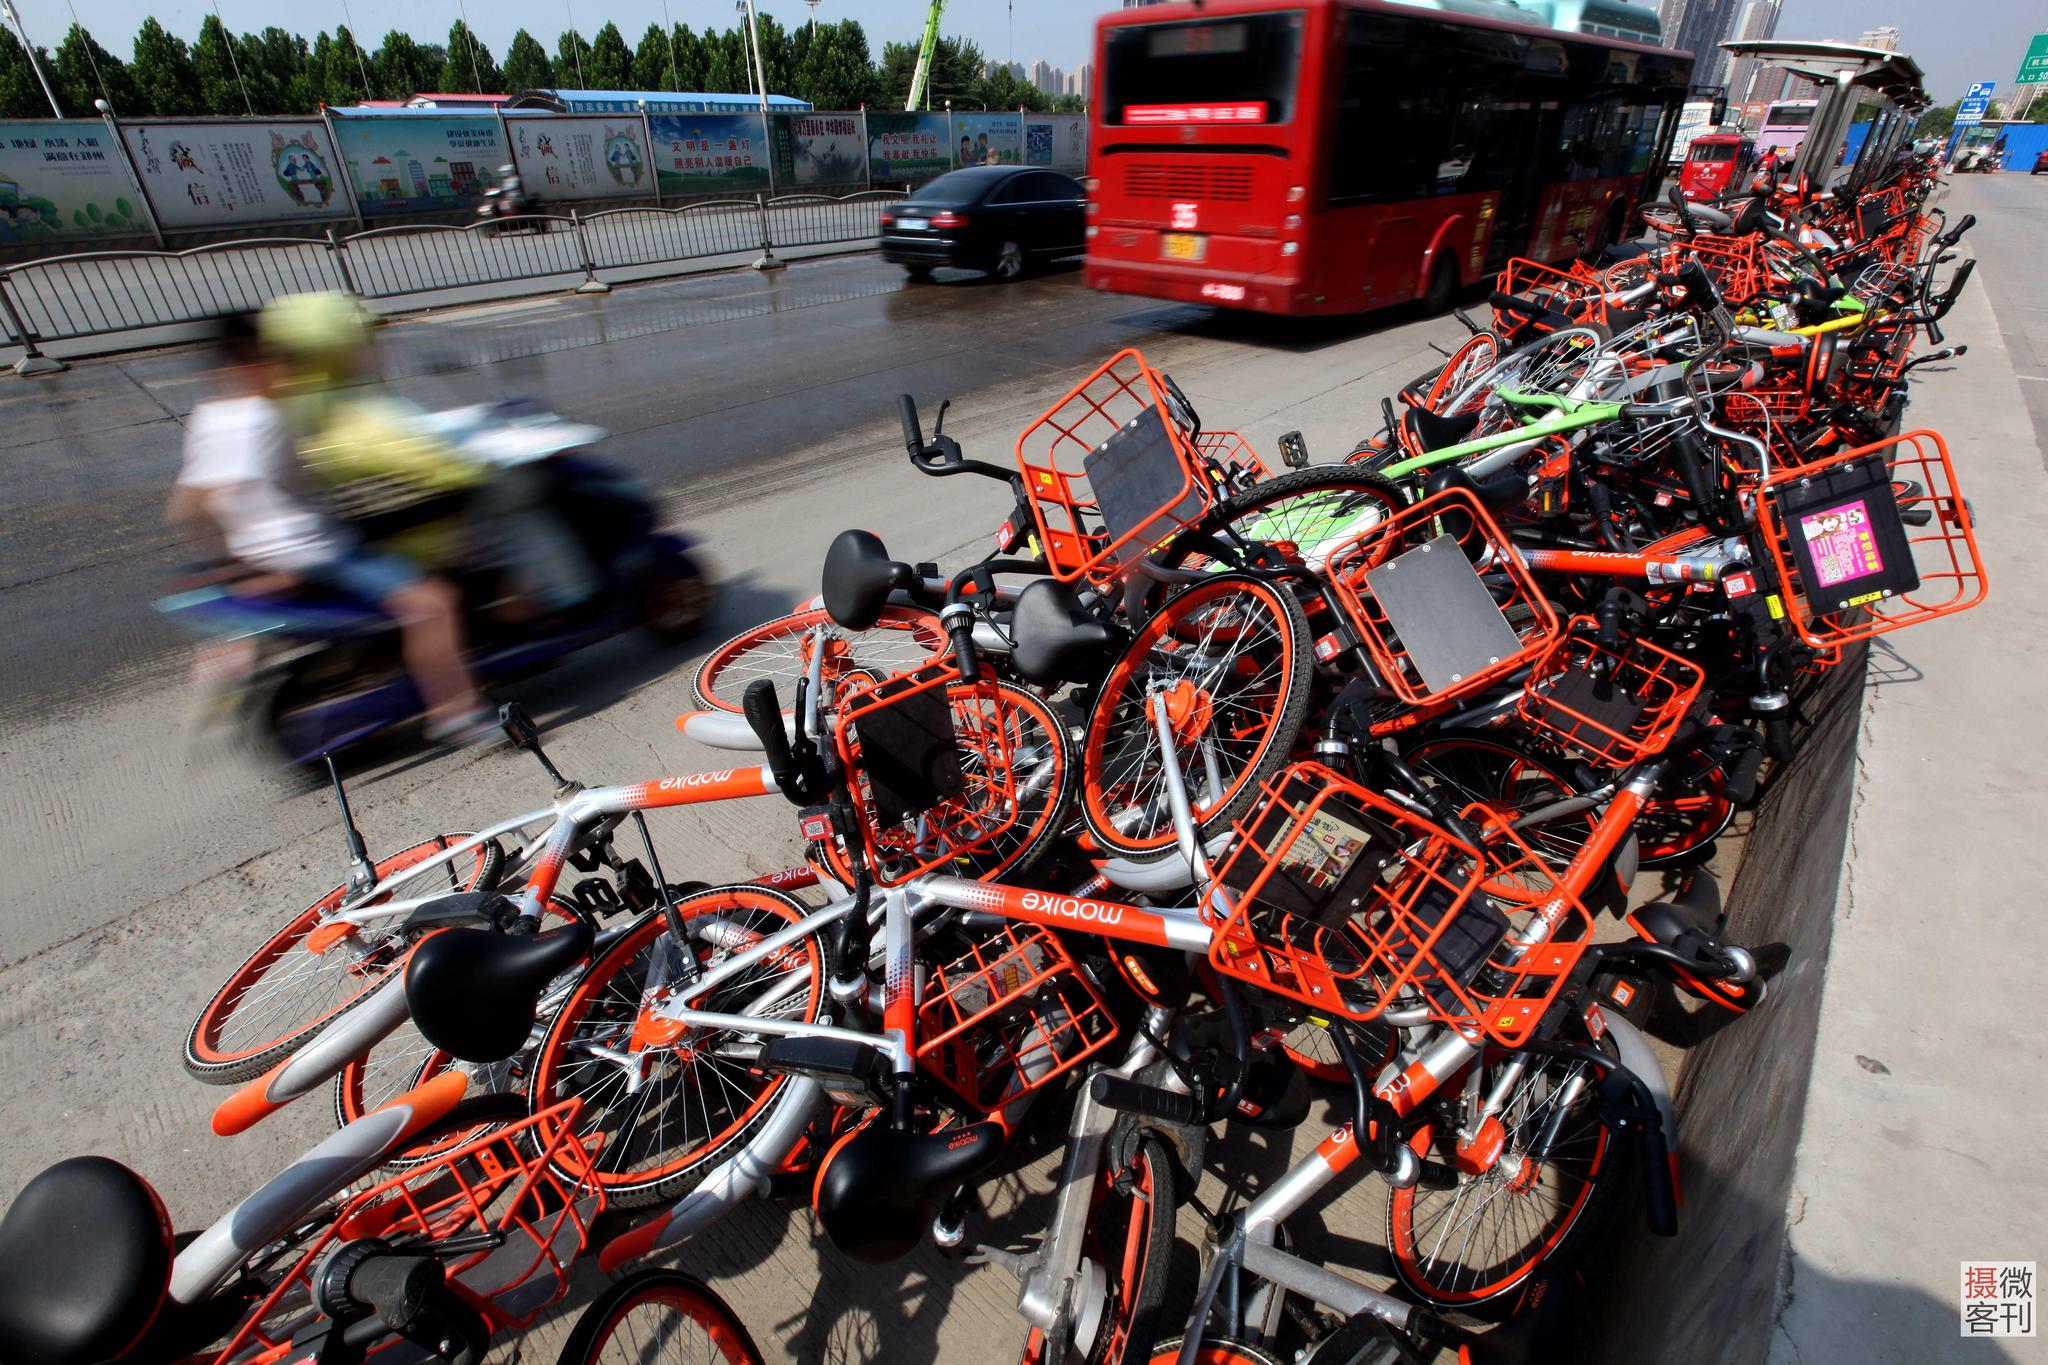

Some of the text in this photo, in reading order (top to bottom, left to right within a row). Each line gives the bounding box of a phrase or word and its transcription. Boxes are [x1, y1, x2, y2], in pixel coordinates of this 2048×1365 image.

[1968, 83, 1982, 97] P
[672, 136, 751, 153] 文明是一盏灯
[674, 155, 752, 169] 照亮别人温暖自己
[659, 768, 735, 791] mobike
[1021, 892, 1124, 926] mobike
